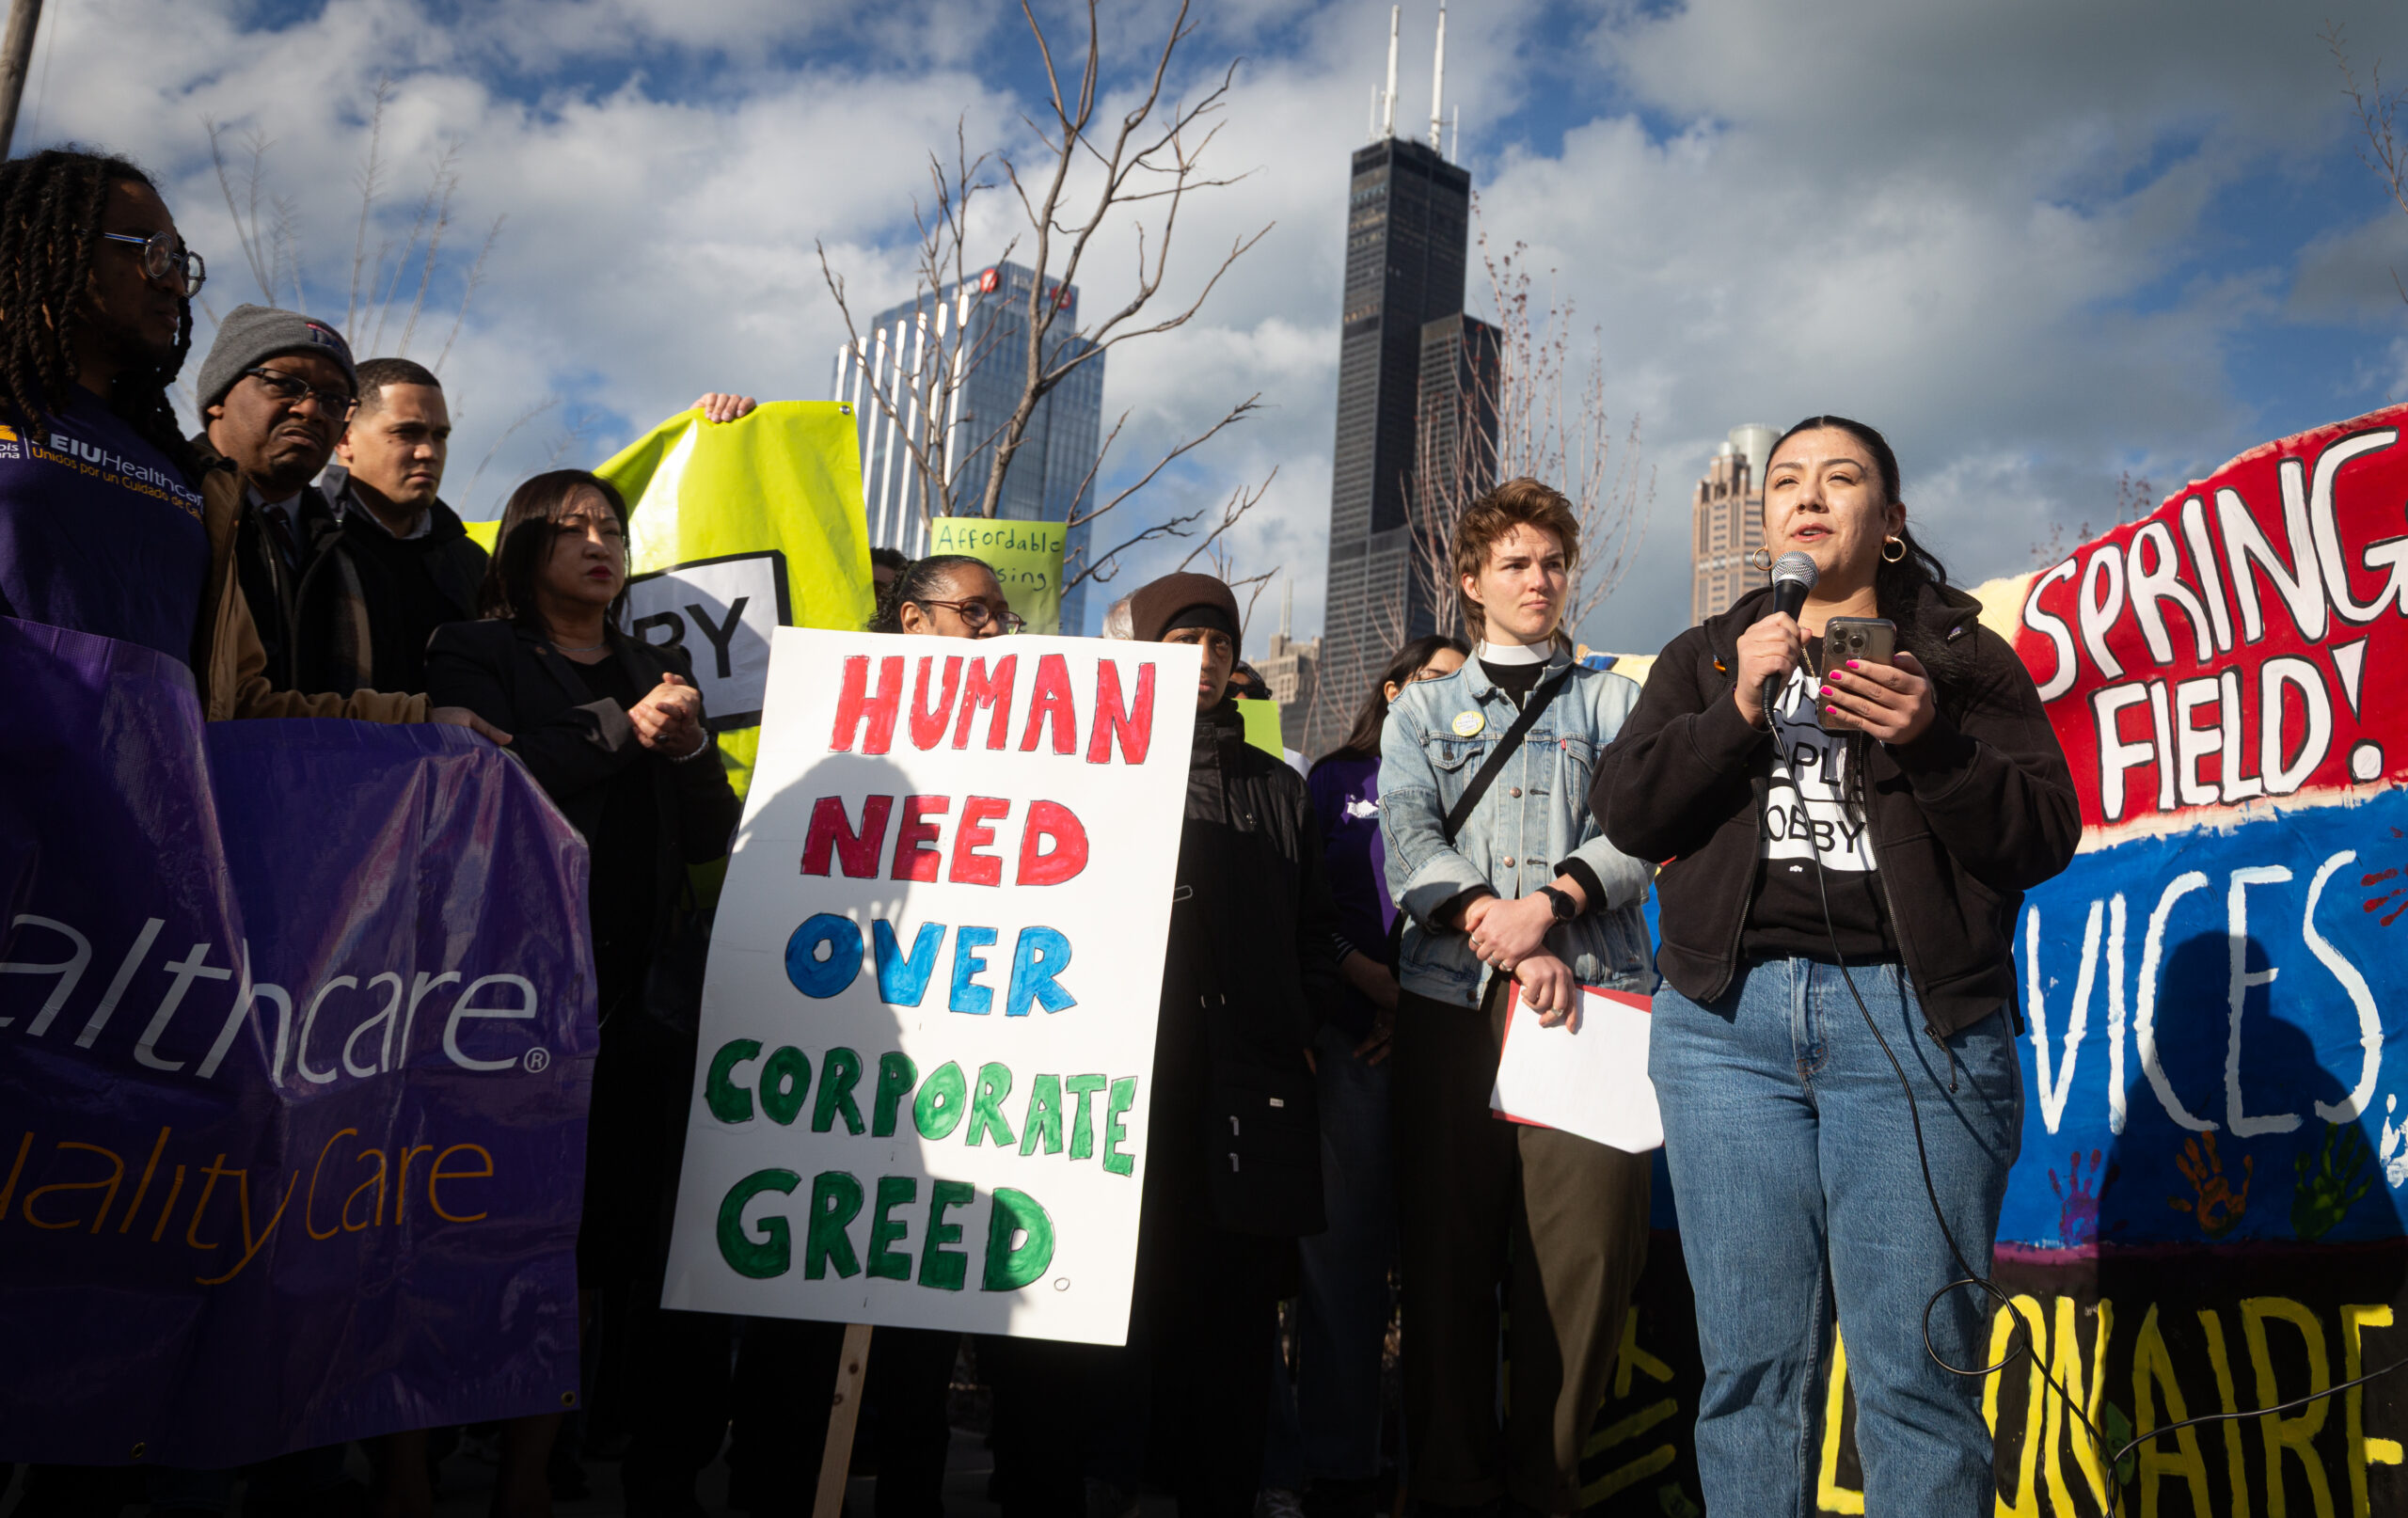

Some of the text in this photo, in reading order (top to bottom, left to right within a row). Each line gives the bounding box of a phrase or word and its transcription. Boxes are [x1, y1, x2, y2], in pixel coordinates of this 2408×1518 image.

[32, 446, 77, 469] Unidos
[80, 463, 100, 475] por
[103, 470, 119, 485] un
[121, 476, 169, 501] Cuidado
[171, 497, 184, 509] de
[937, 525, 1061, 553] Affordable
[995, 567, 1047, 592] sing
[2021, 424, 2408, 704] SPRING
[829, 653, 1157, 765] HUMAN
[2085, 634, 2385, 824] FIELD!
[800, 794, 1089, 887] NEED
[1764, 804, 1865, 854] OBBY
[784, 912, 1078, 1018] OVER
[704, 1037, 1138, 1178] CORPORATE
[306, 1128, 494, 1241] Care
